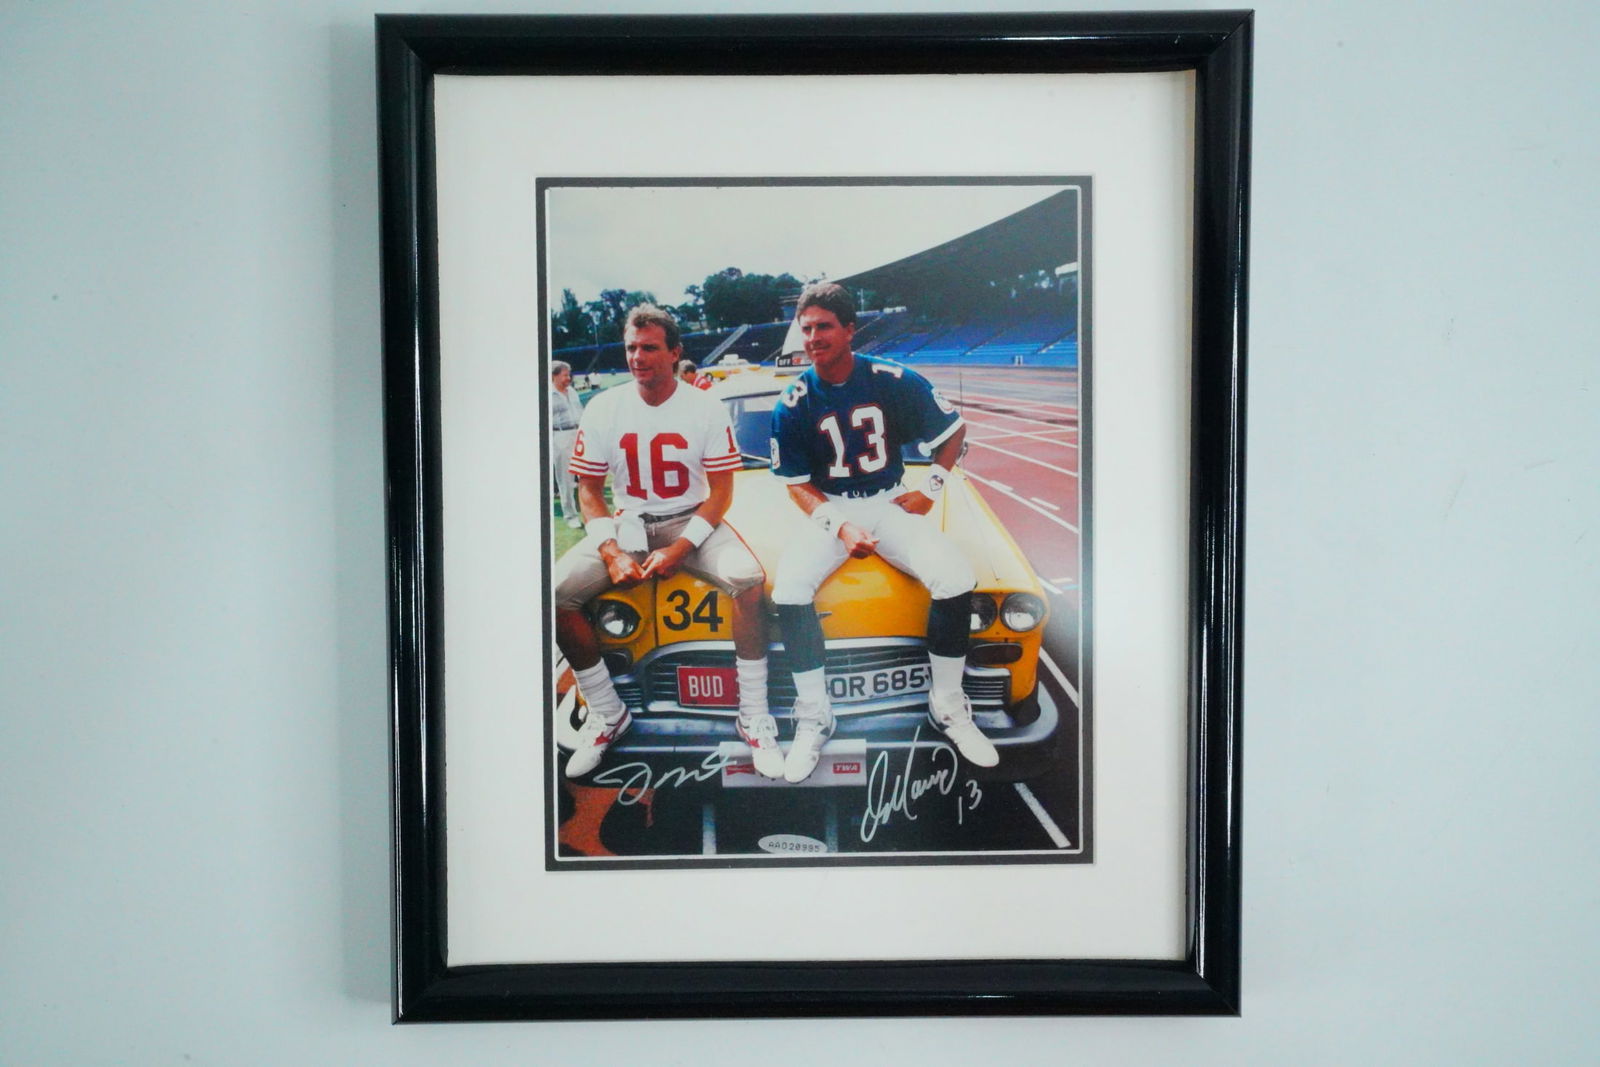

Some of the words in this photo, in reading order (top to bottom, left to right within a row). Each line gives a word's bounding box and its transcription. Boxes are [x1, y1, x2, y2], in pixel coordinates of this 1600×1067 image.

[574, 429, 585, 457] 6
[817, 403, 888, 478] 13
[619, 432, 690, 501] 16
[662, 588, 723, 633] 34
[687, 674, 724, 698] BUD
[825, 676, 866, 698] OR
[957, 779, 984, 825] 13
